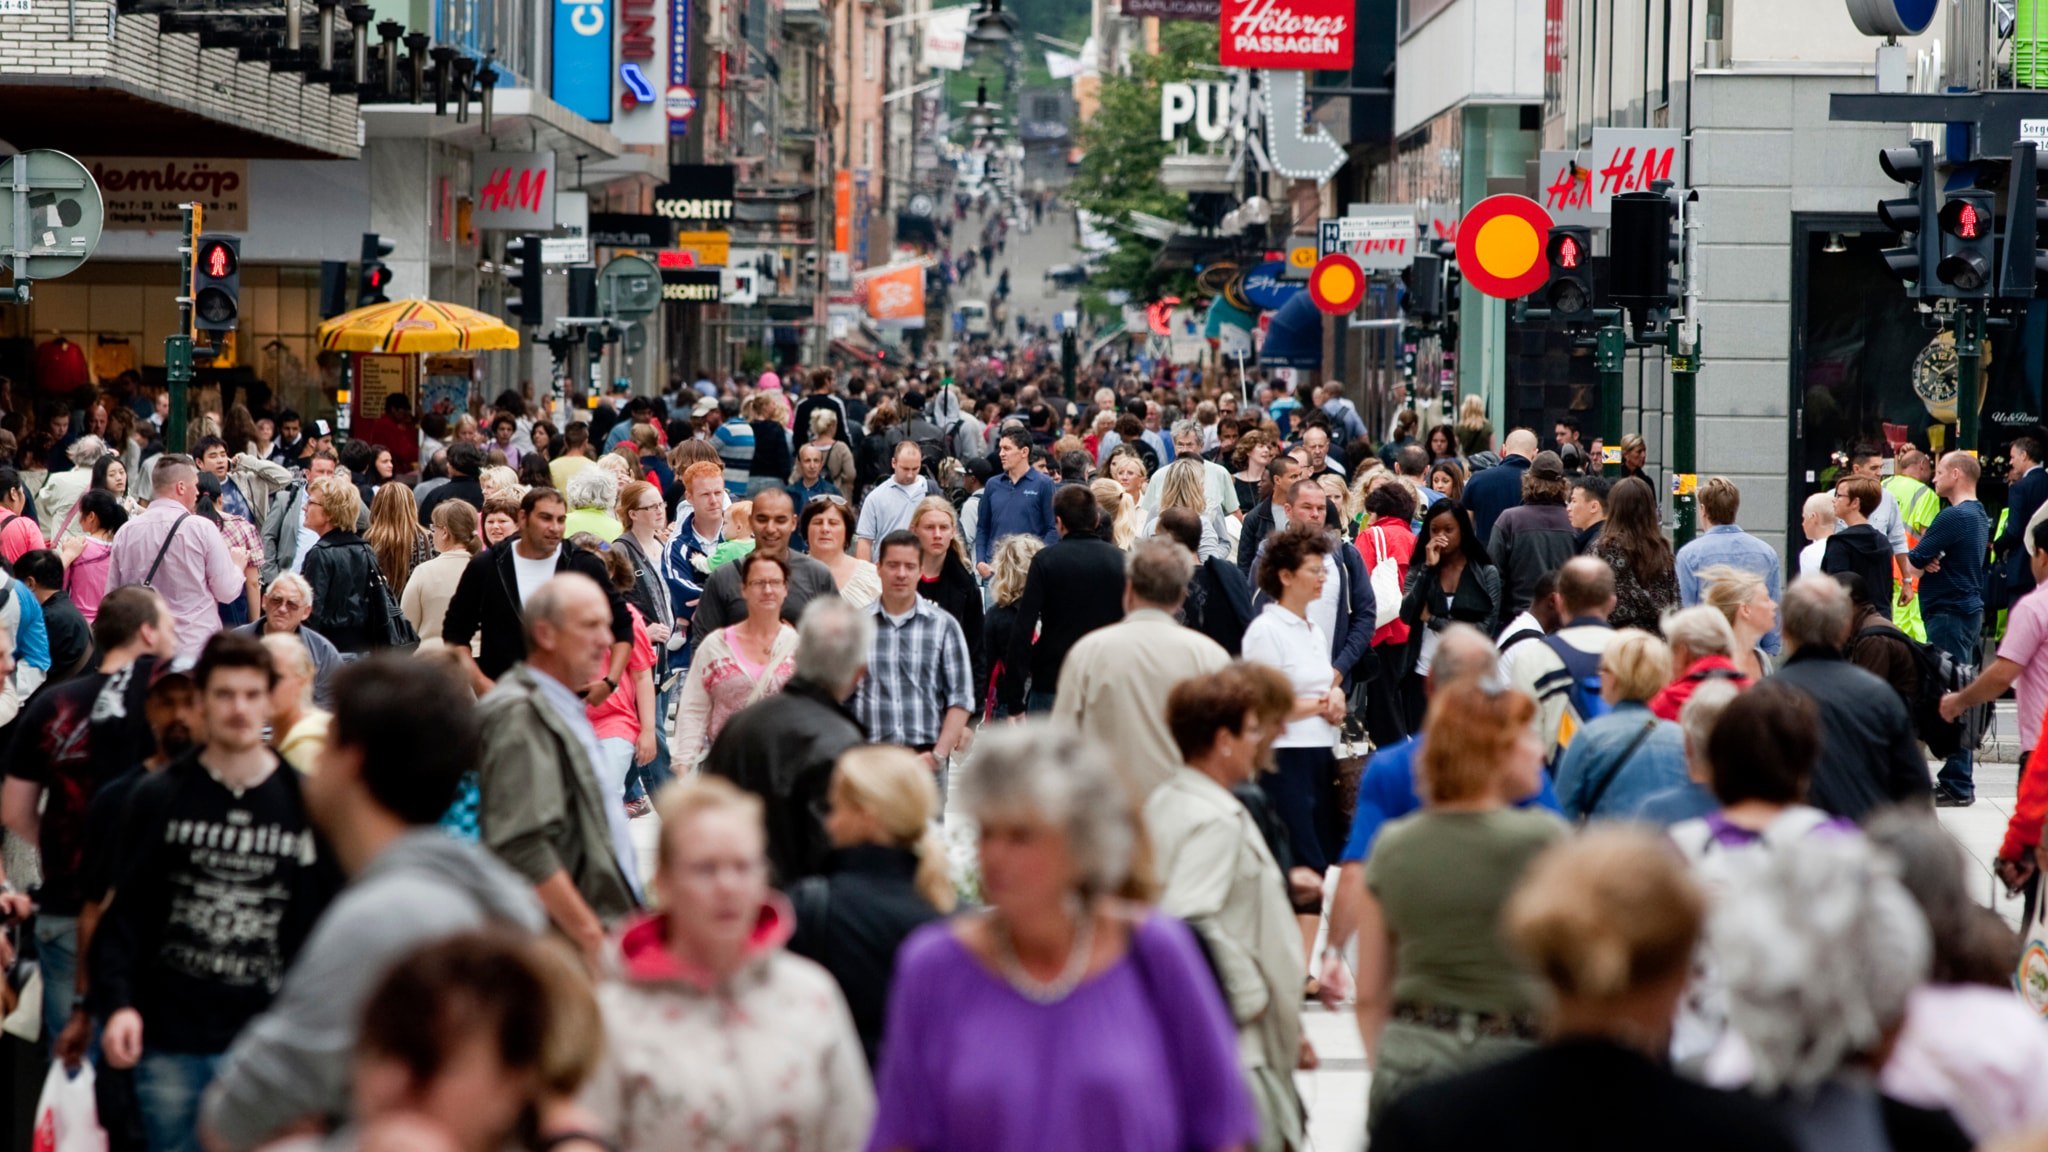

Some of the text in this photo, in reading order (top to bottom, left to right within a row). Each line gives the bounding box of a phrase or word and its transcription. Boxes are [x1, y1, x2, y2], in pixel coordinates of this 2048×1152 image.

[1229, 0, 1347, 37] Hötorgs
[1234, 35, 1339, 54] PASSAGEN
[2023, 123, 2048, 136] Serg
[1600, 147, 1675, 194] H&M
[480, 166, 547, 214] H&M
[655, 199, 732, 219] SCORETT
[664, 284, 719, 300] SCORETT
